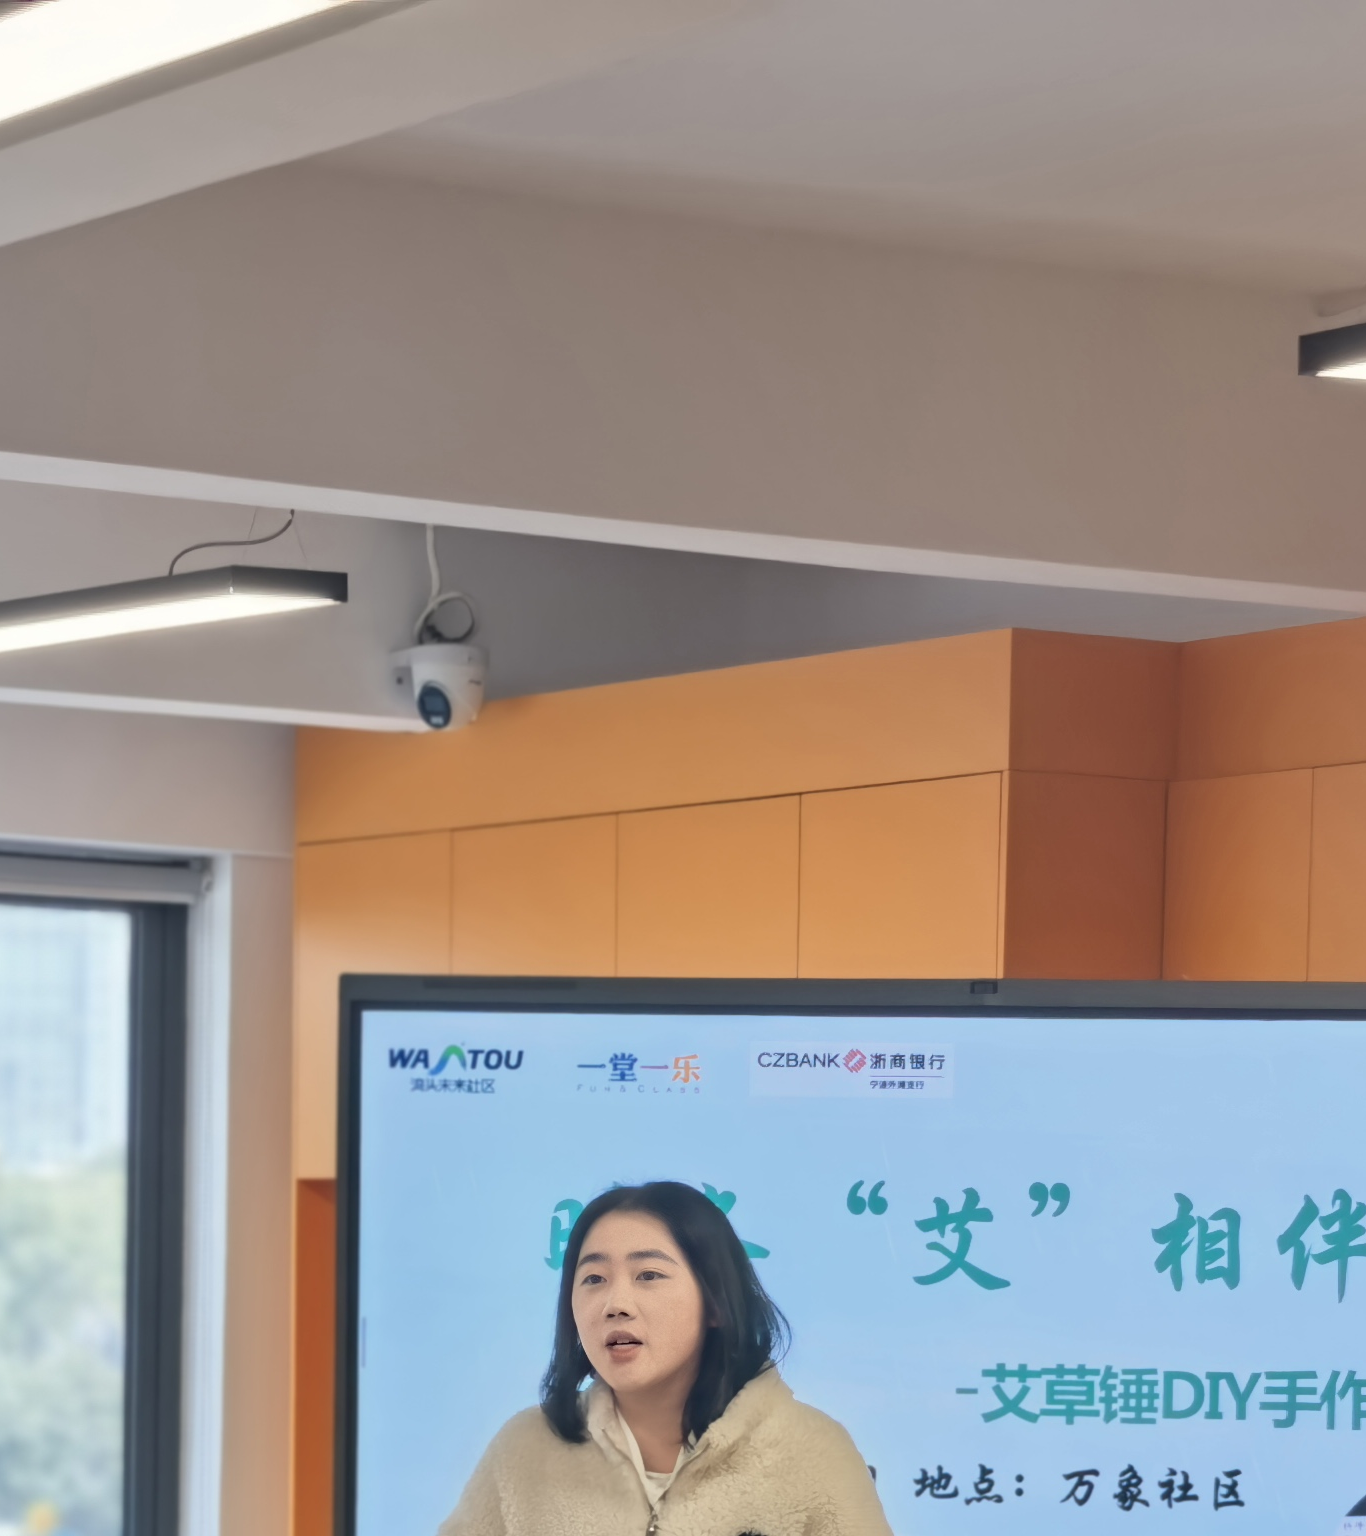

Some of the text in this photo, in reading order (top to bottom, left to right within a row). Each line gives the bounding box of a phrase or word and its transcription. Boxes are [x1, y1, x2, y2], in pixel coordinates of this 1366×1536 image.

[576, 1052, 701, 1083] 一堂一乐
[757, 1052, 840, 1068] CZBANK
[869, 1053, 946, 1070] 浙商银行
